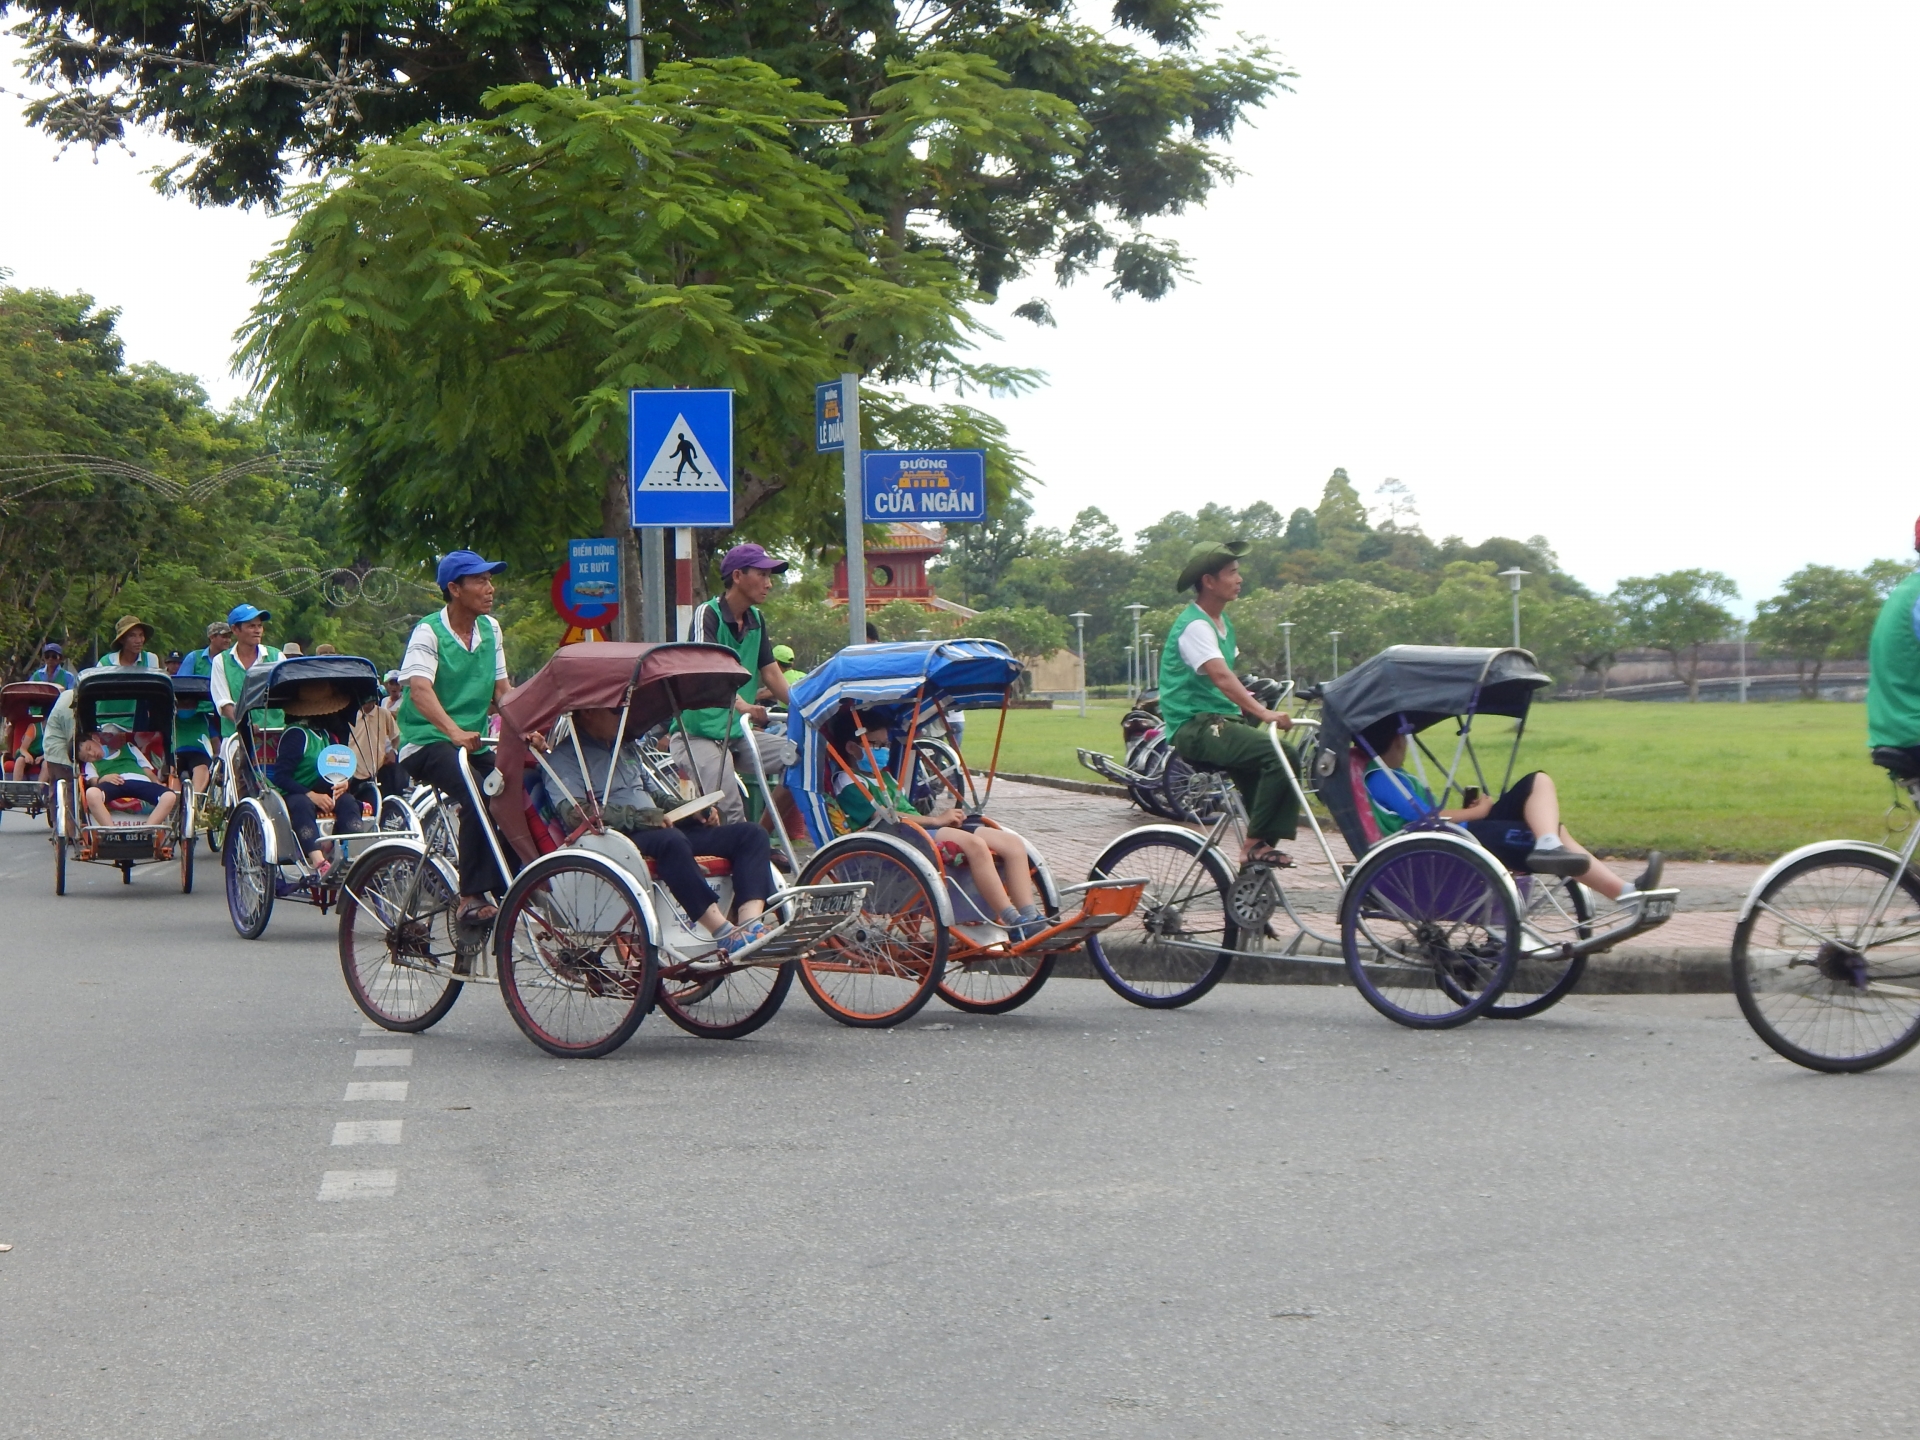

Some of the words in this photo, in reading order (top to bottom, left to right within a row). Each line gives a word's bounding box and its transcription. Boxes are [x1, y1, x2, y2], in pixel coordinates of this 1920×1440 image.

[820, 420, 828, 445] LÊ
[900, 457, 948, 469] ĐƯỜNG
[875, 484, 915, 513] CỬA
[921, 488, 975, 512] NGĂN
[578, 563, 589, 573] XE
[590, 560, 610, 573] BUÝT
